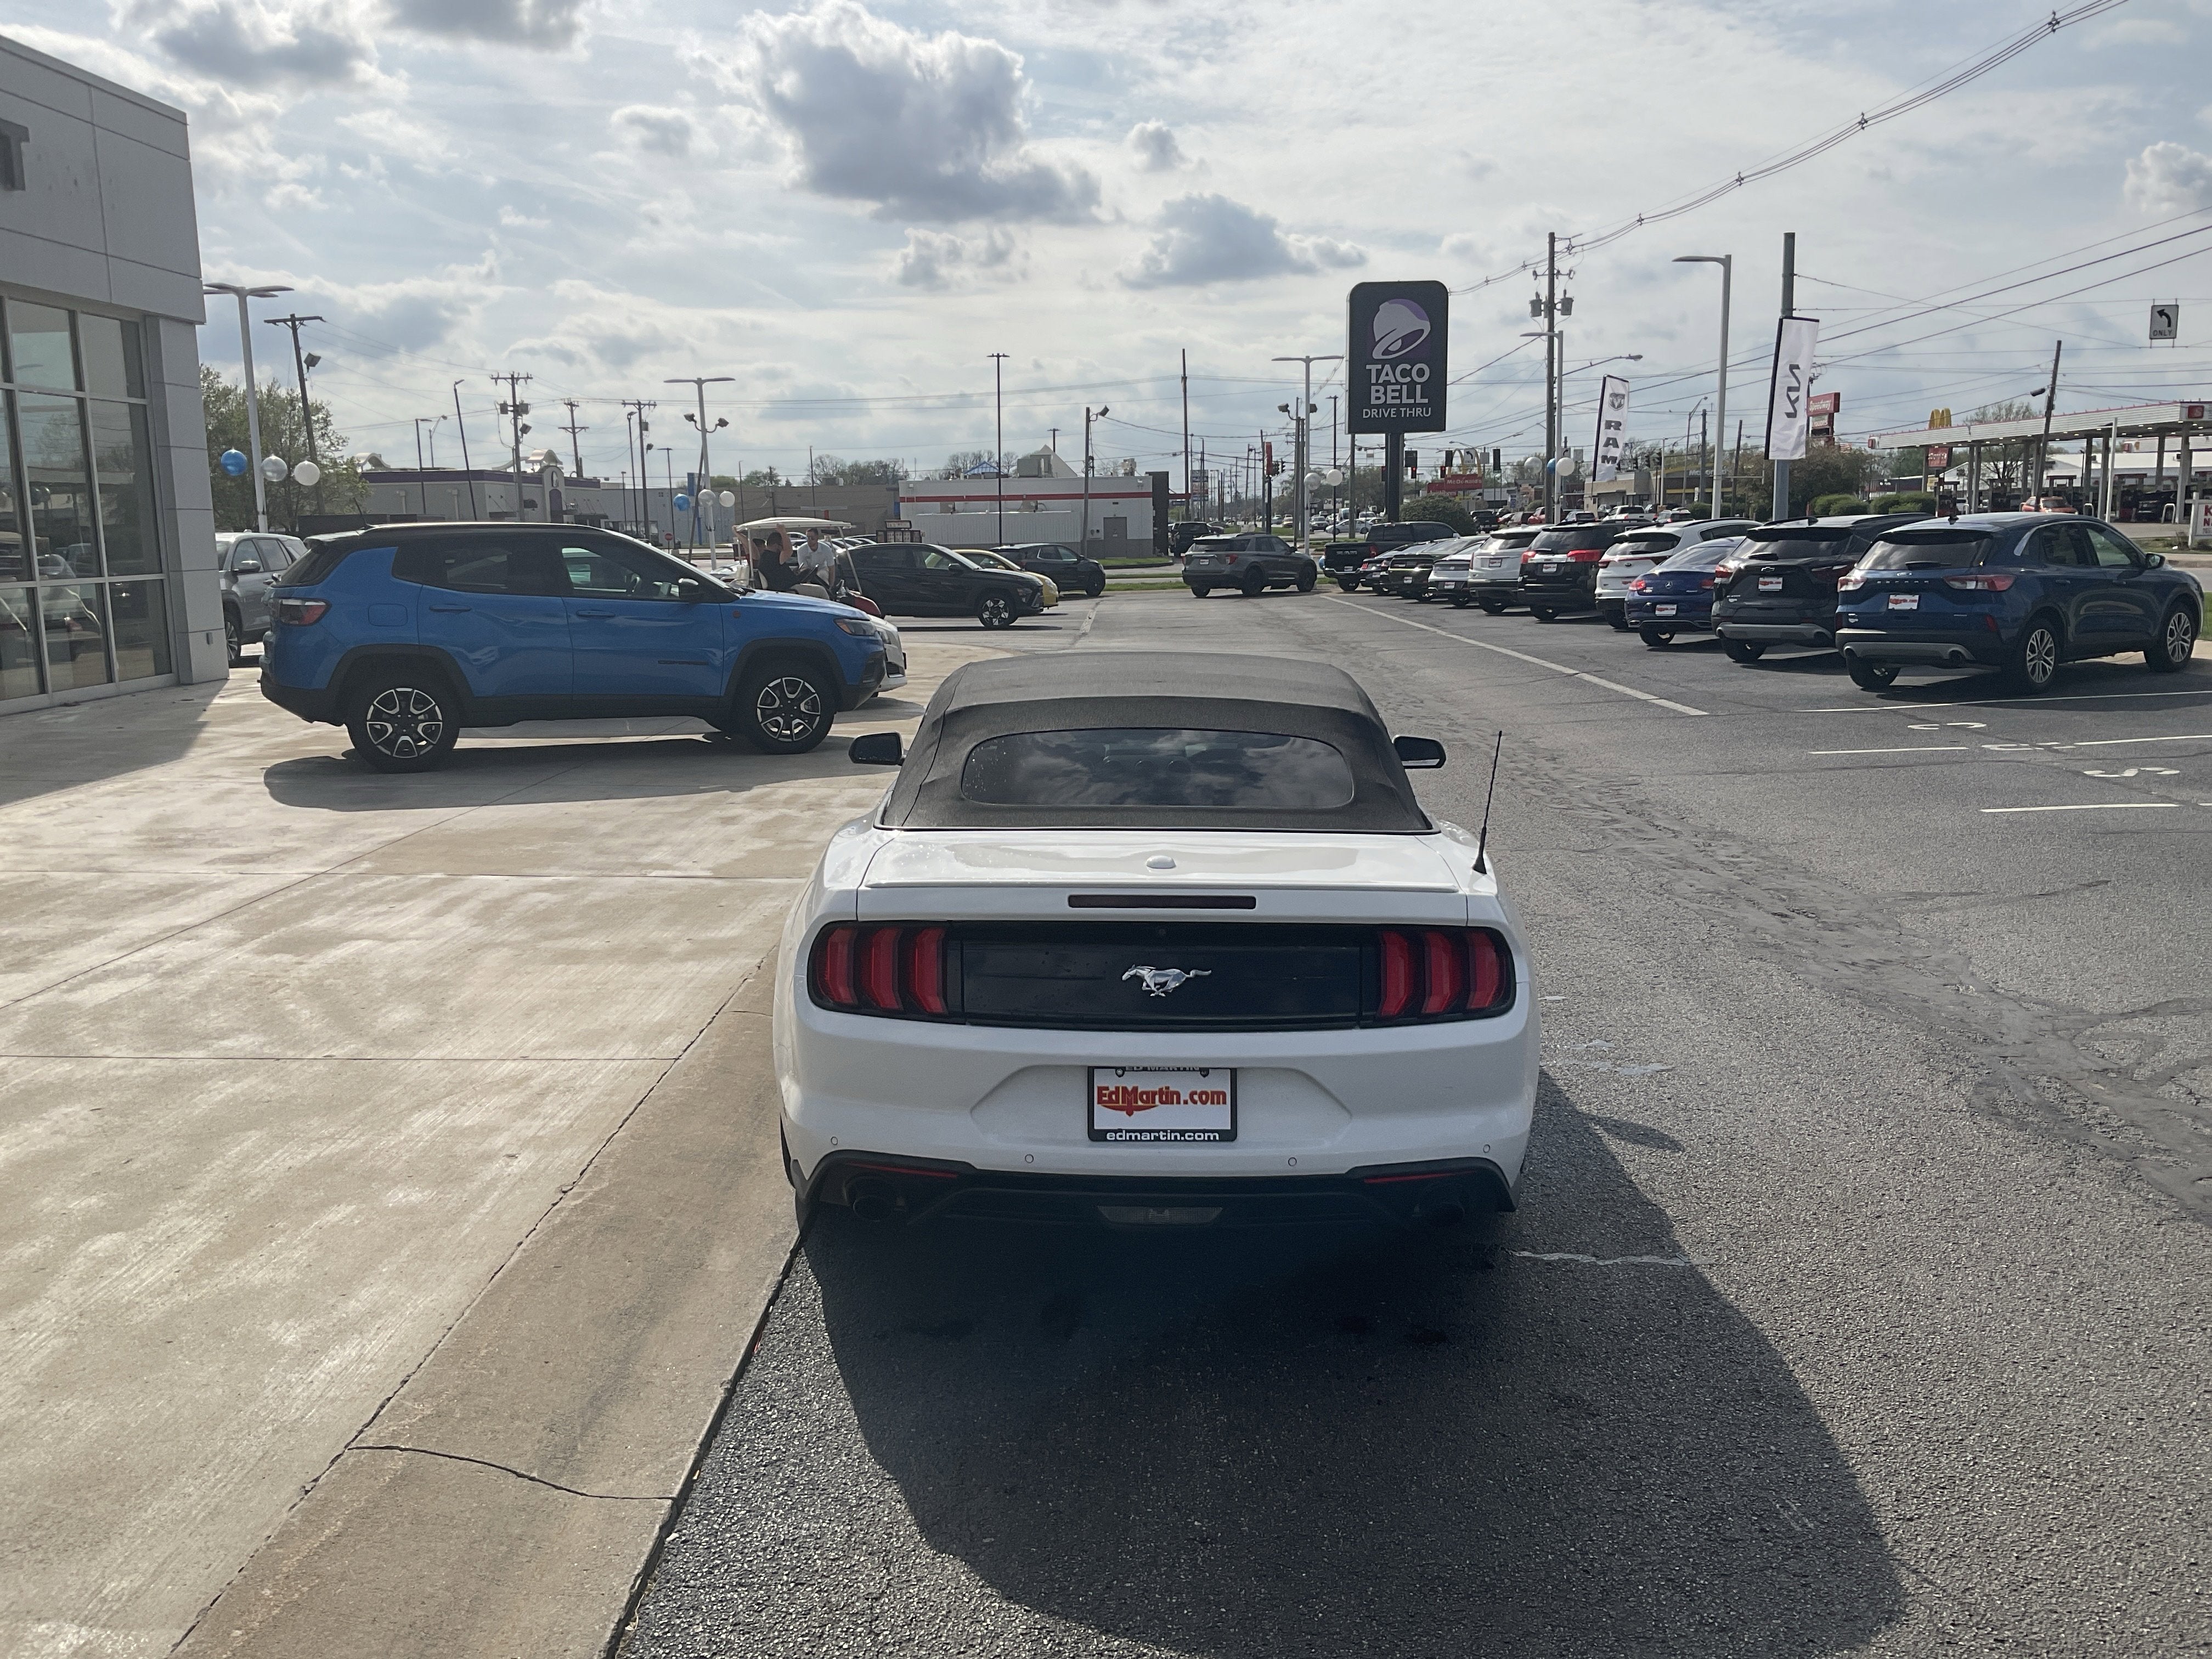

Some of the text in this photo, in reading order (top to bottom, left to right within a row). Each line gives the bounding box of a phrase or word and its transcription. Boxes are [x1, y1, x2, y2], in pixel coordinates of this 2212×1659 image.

[1365, 363, 1430, 383] TACO
[1370, 385, 1429, 405] BELL
[1362, 407, 1431, 419] DRIVE THRU
[1809, 399, 1832, 413] Speedway
[1600, 420, 1622, 465] RAM
[1096, 1085, 1228, 1105] EdMartin.com
[1105, 1130, 1220, 1141] edmartin.com
